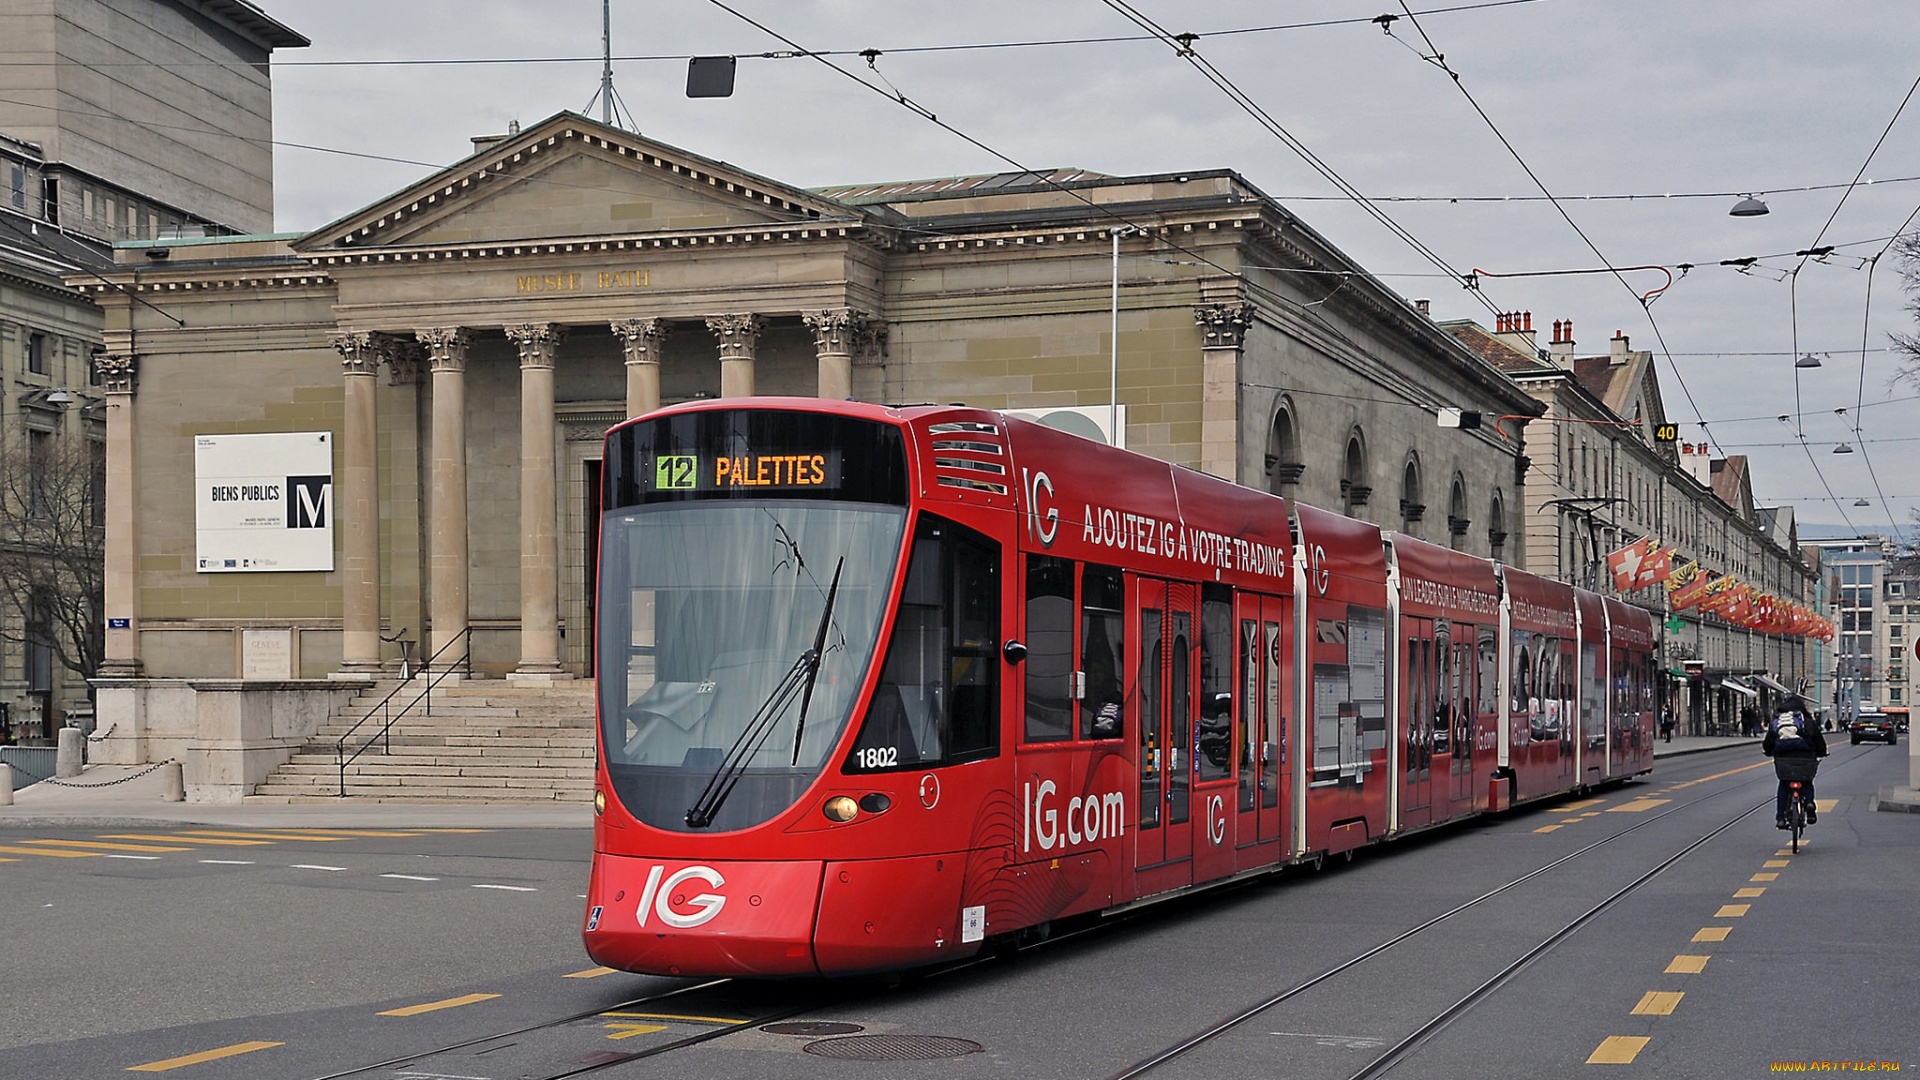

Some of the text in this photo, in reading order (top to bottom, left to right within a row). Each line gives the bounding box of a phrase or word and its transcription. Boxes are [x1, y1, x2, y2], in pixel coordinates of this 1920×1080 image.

[598, 269, 650, 289] RATH
[1657, 426, 1675, 440] 40
[660, 455, 825, 487] 12 PALETTES
[212, 485, 279, 502] BIENS PUBLICS
[1022, 467, 1059, 549] IG
[1083, 504, 1285, 578] AJOUTEZ IG À VOTRE TRADING
[1310, 543, 1329, 596] IG
[1402, 575, 1413, 602] UN
[1414, 578, 1437, 606] LEADER
[856, 746, 898, 769] 1802
[1024, 779, 1125, 853] IG.com
[1207, 794, 1225, 848] IG
[635, 865, 727, 929] IG
